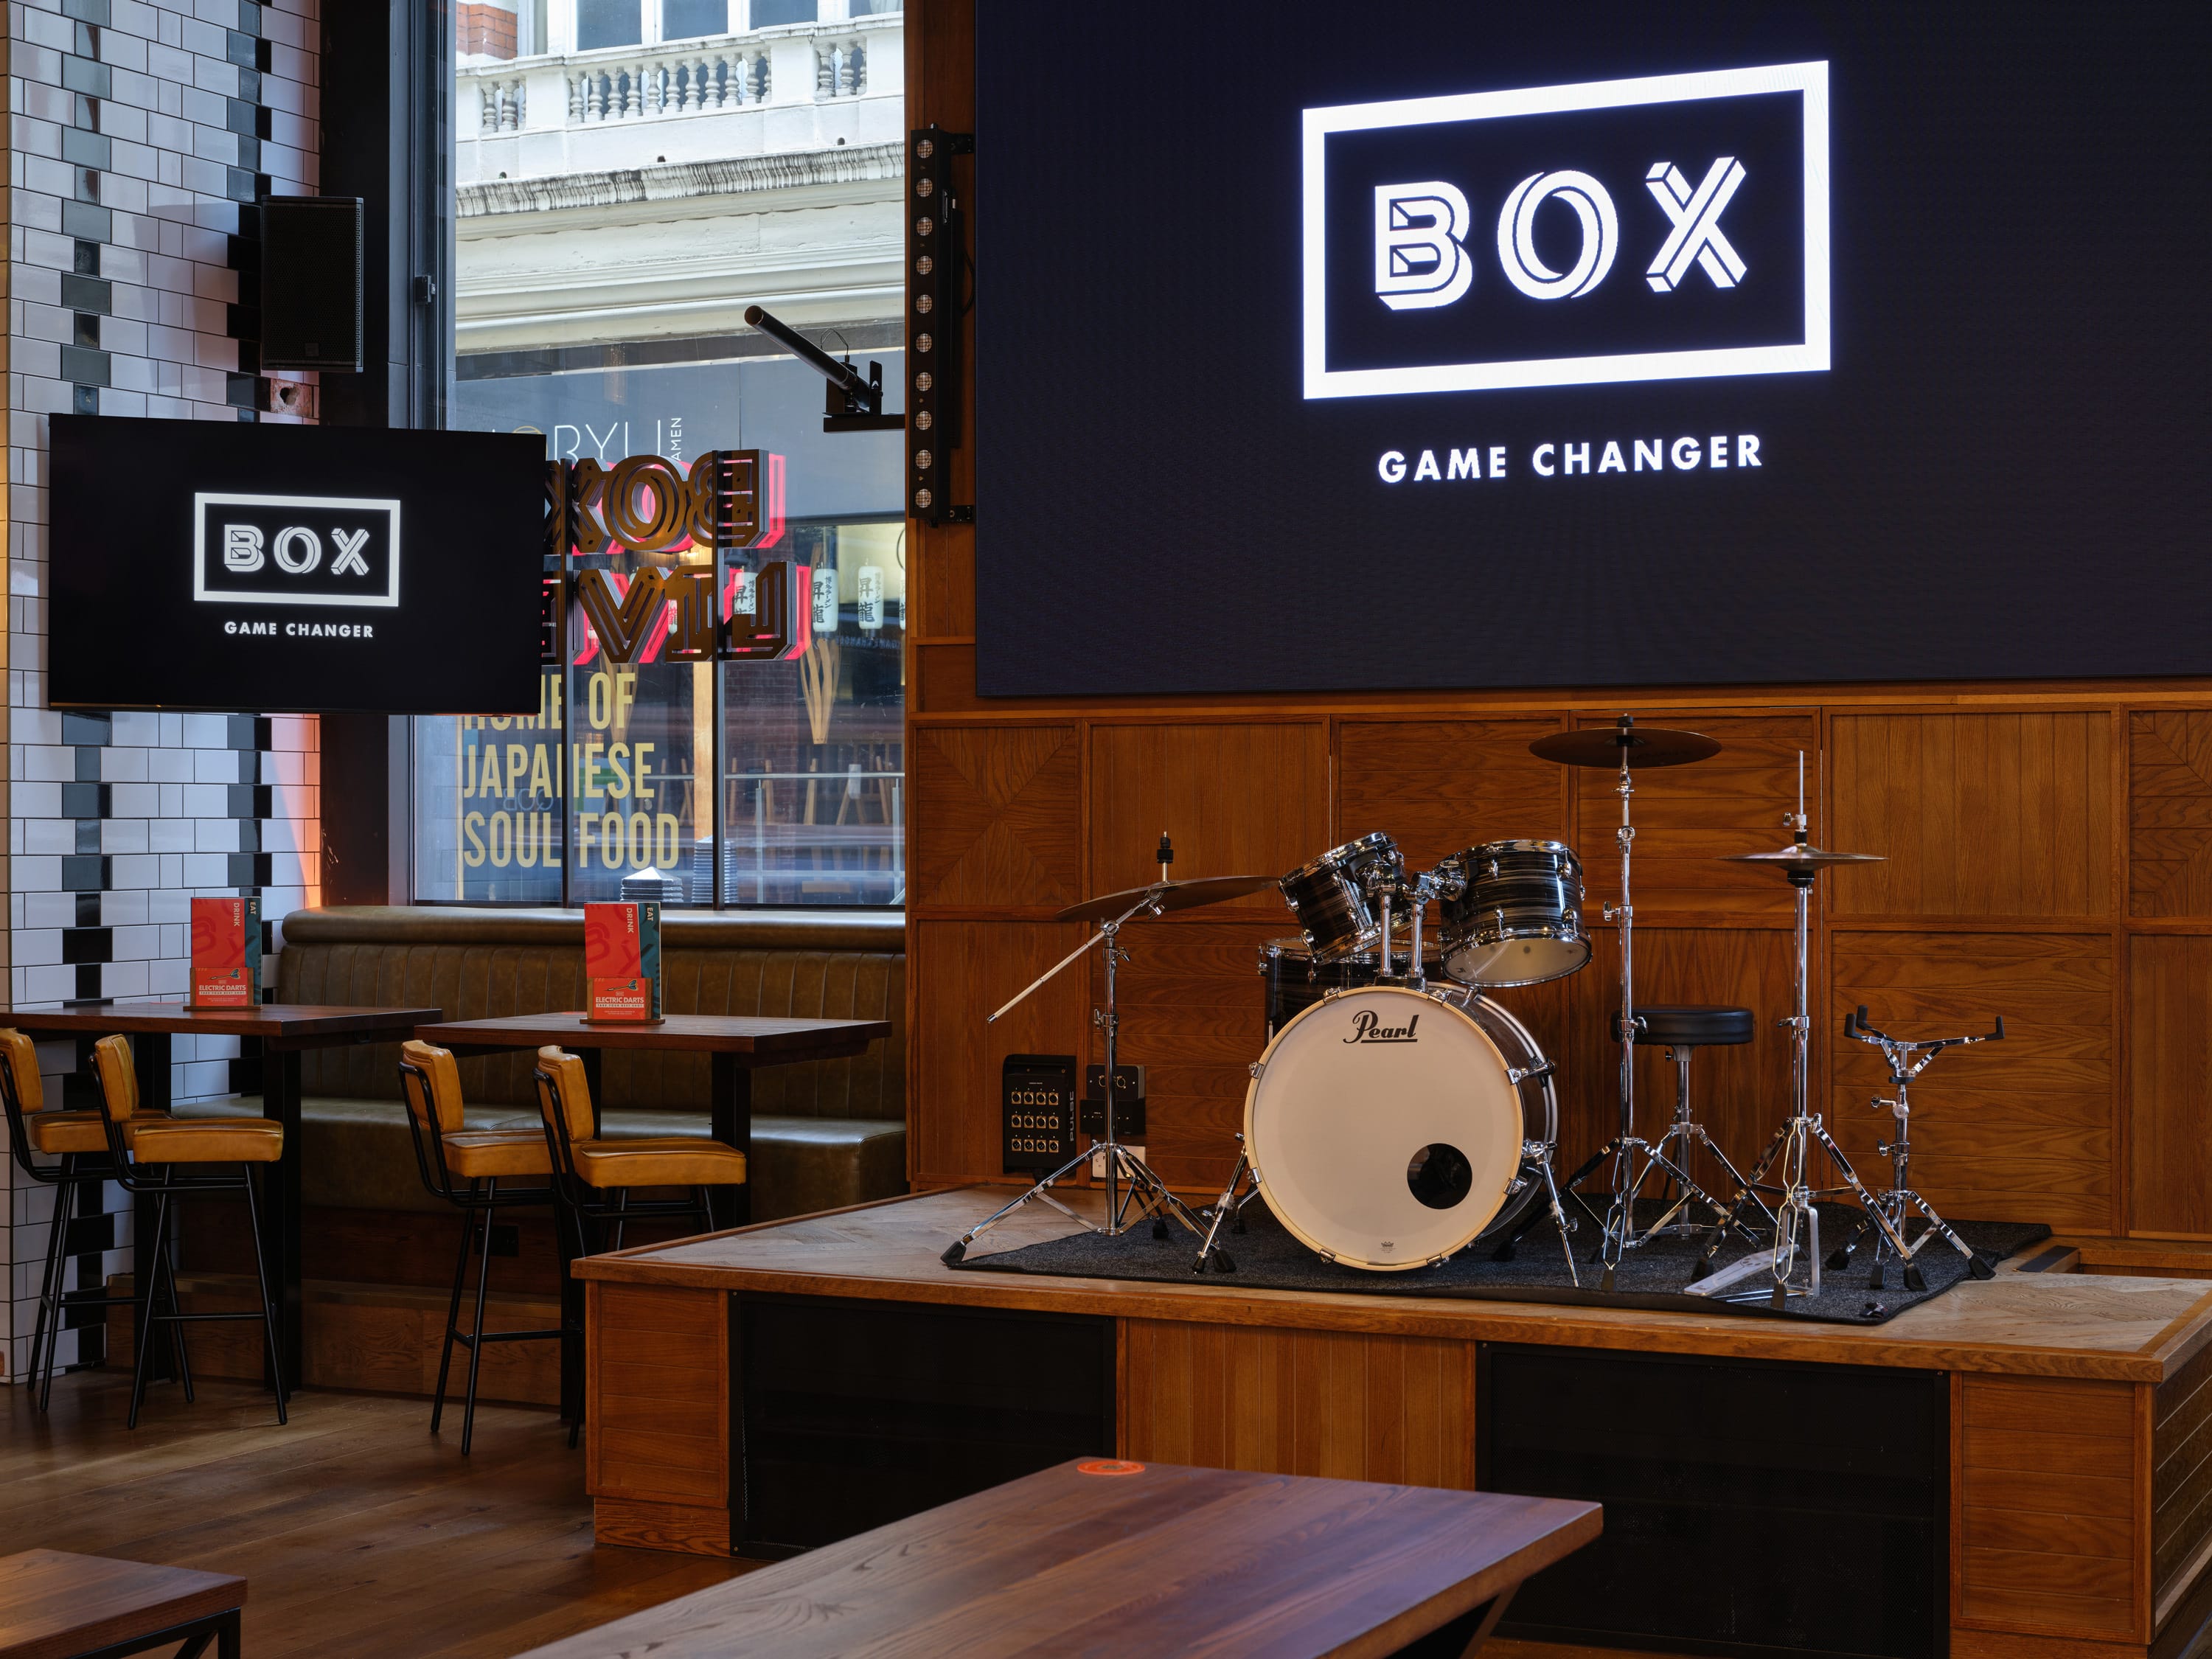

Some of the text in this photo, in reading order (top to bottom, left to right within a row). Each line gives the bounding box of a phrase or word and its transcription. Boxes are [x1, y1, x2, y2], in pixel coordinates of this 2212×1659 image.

[1374, 156, 1747, 311] BOX
[670, 417, 682, 462] AMEN
[1378, 434, 1762, 484] GAME CHANGER
[223, 524, 370, 576] BOX
[223, 621, 373, 639] GAME CHANGER
[588, 672, 636, 730] OF
[465, 812, 679, 869] SOUL FOOD
[626, 908, 634, 933] DRINK
[1343, 1010, 1419, 1044] Pearl
